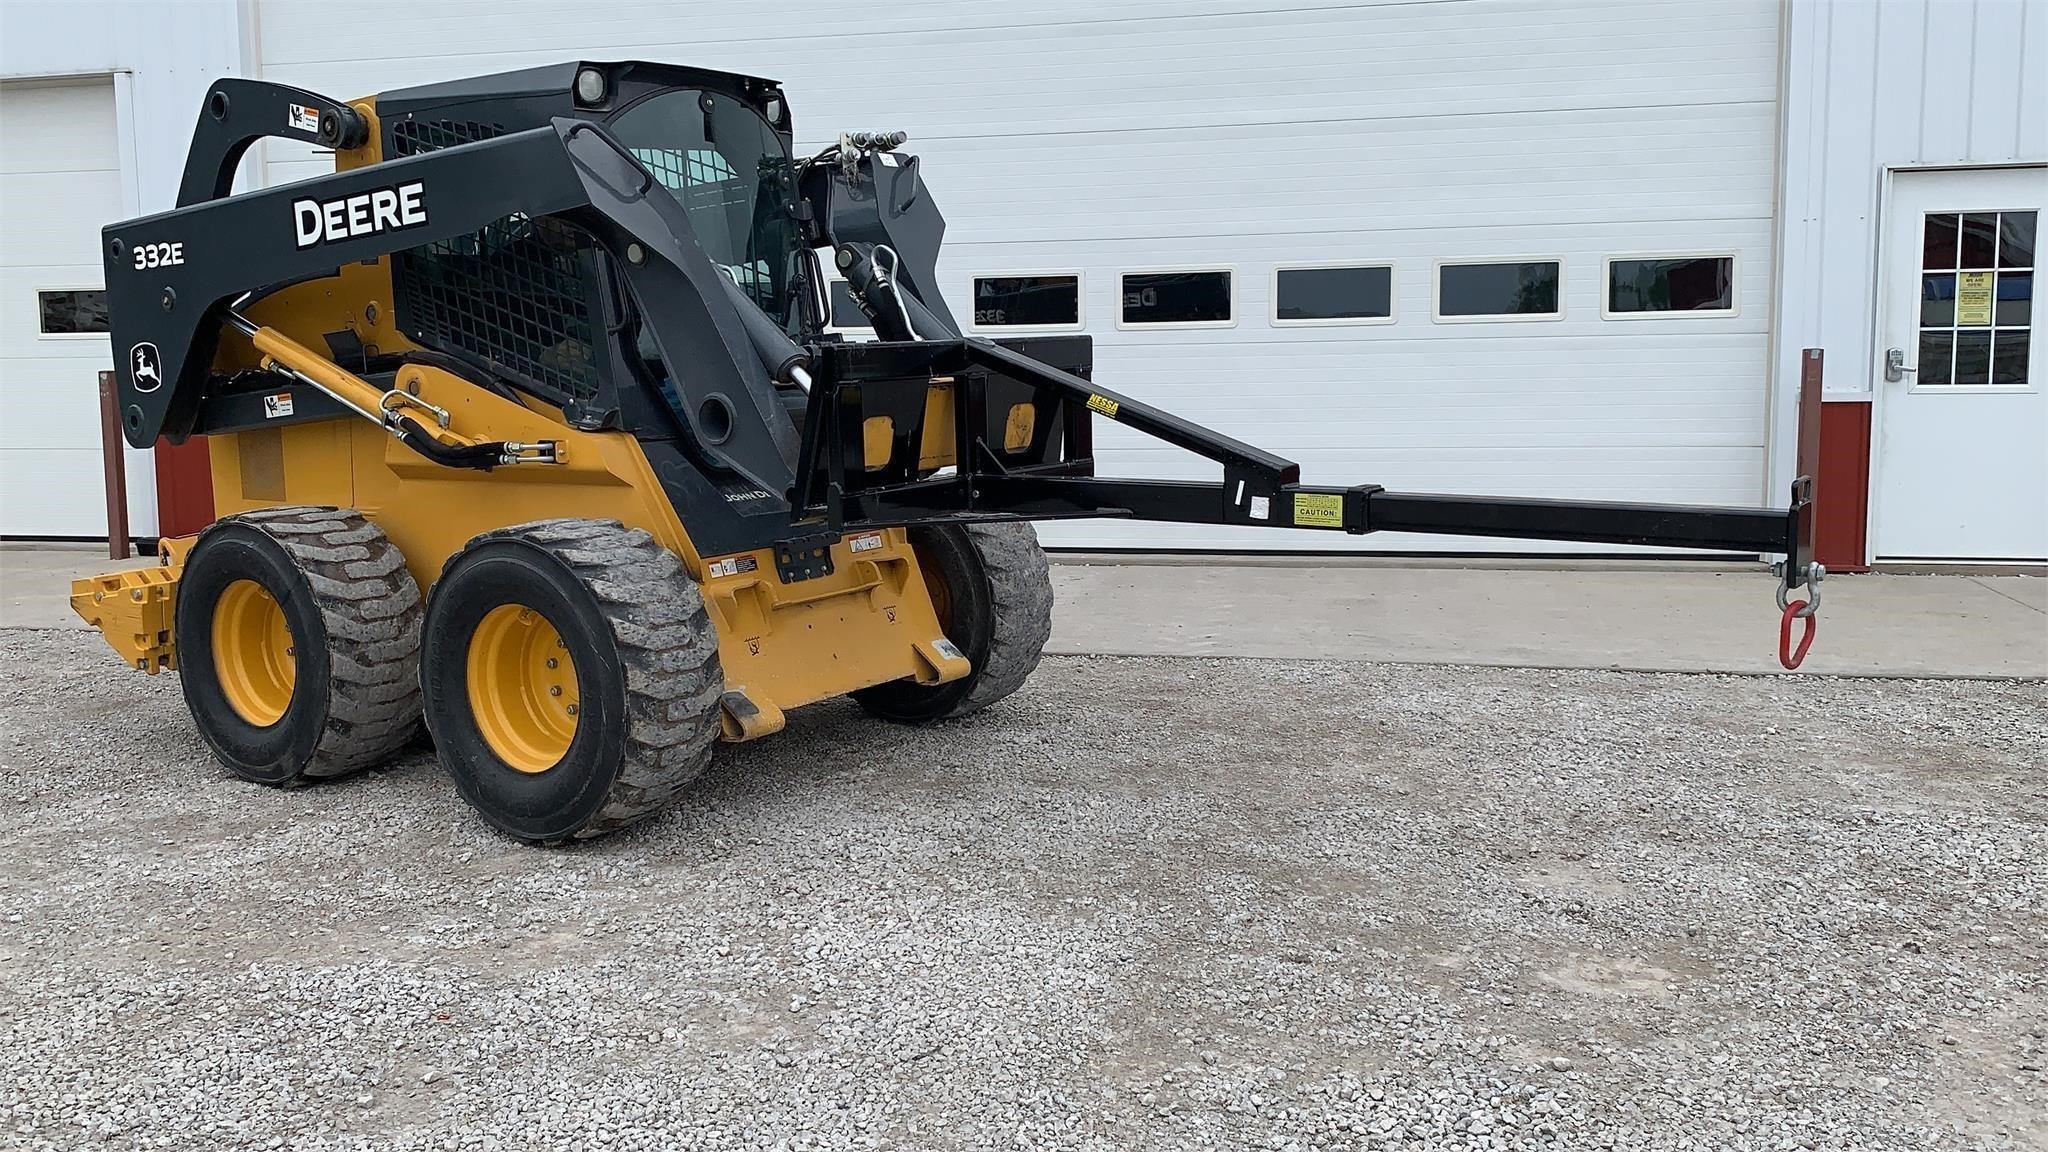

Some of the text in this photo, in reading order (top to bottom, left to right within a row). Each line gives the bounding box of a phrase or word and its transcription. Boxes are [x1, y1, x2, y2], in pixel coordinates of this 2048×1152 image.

[294, 182, 426, 247] DEERE
[133, 242, 184, 270] 332E
[1089, 393, 1119, 411] NESSA
[724, 492, 757, 502] JOHN
